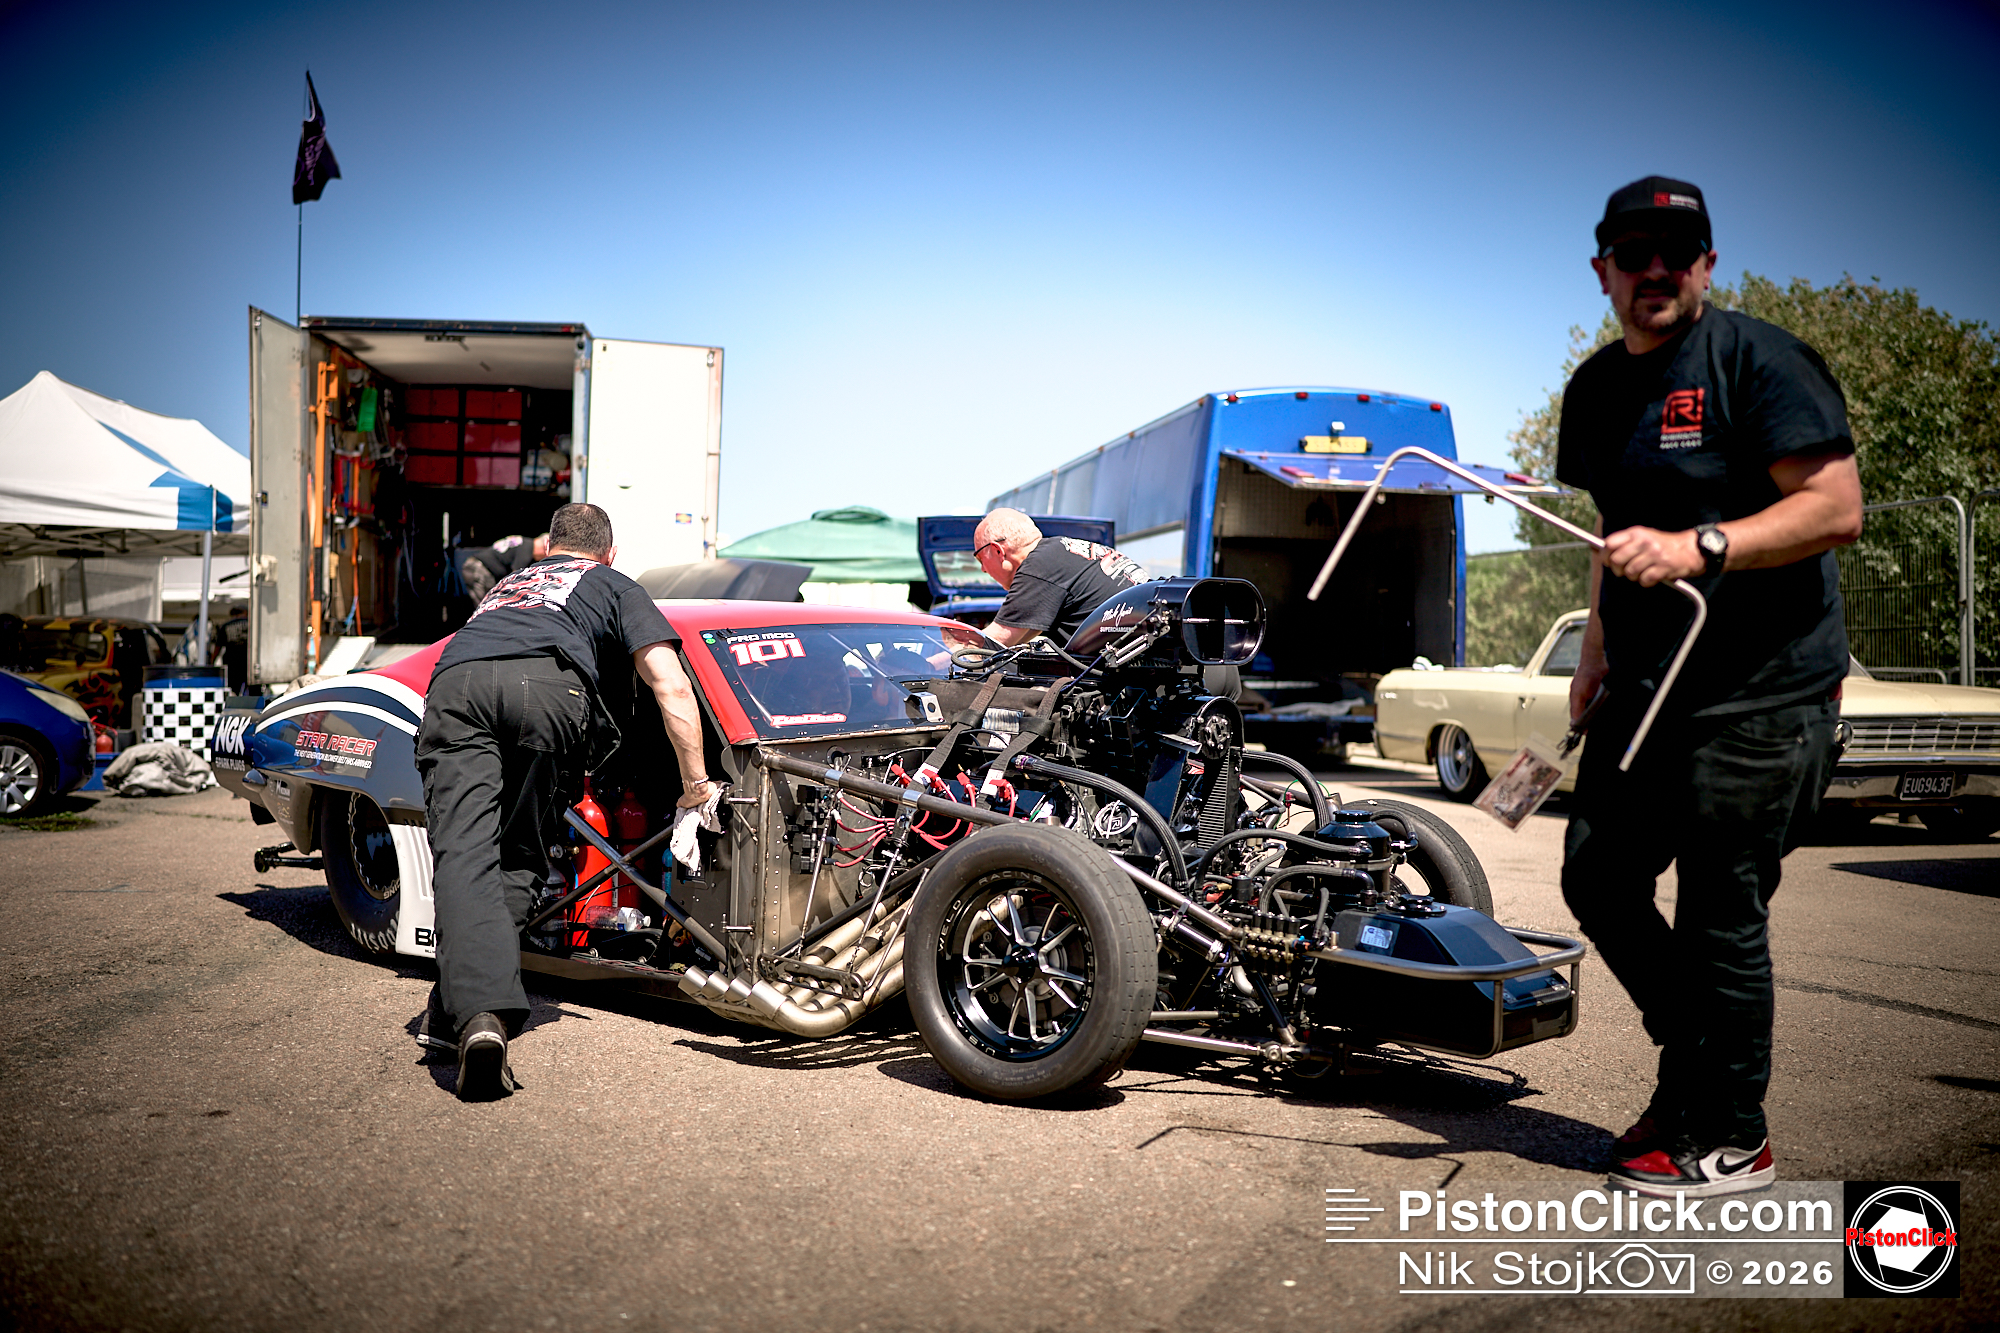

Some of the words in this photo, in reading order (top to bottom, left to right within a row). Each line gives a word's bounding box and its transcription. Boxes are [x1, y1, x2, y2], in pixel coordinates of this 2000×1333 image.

[729, 638, 807, 667] 101
[214, 716, 252, 756] NGK
[295, 730, 328, 749] STAR
[326, 734, 377, 757] RACER
[215, 757, 230, 769] SPARK
[230, 758, 246, 772] PLUGS
[1903, 776, 1953, 793] EUG943F
[978, 870, 1043, 887] RACING
[937, 899, 962, 952] WELD
